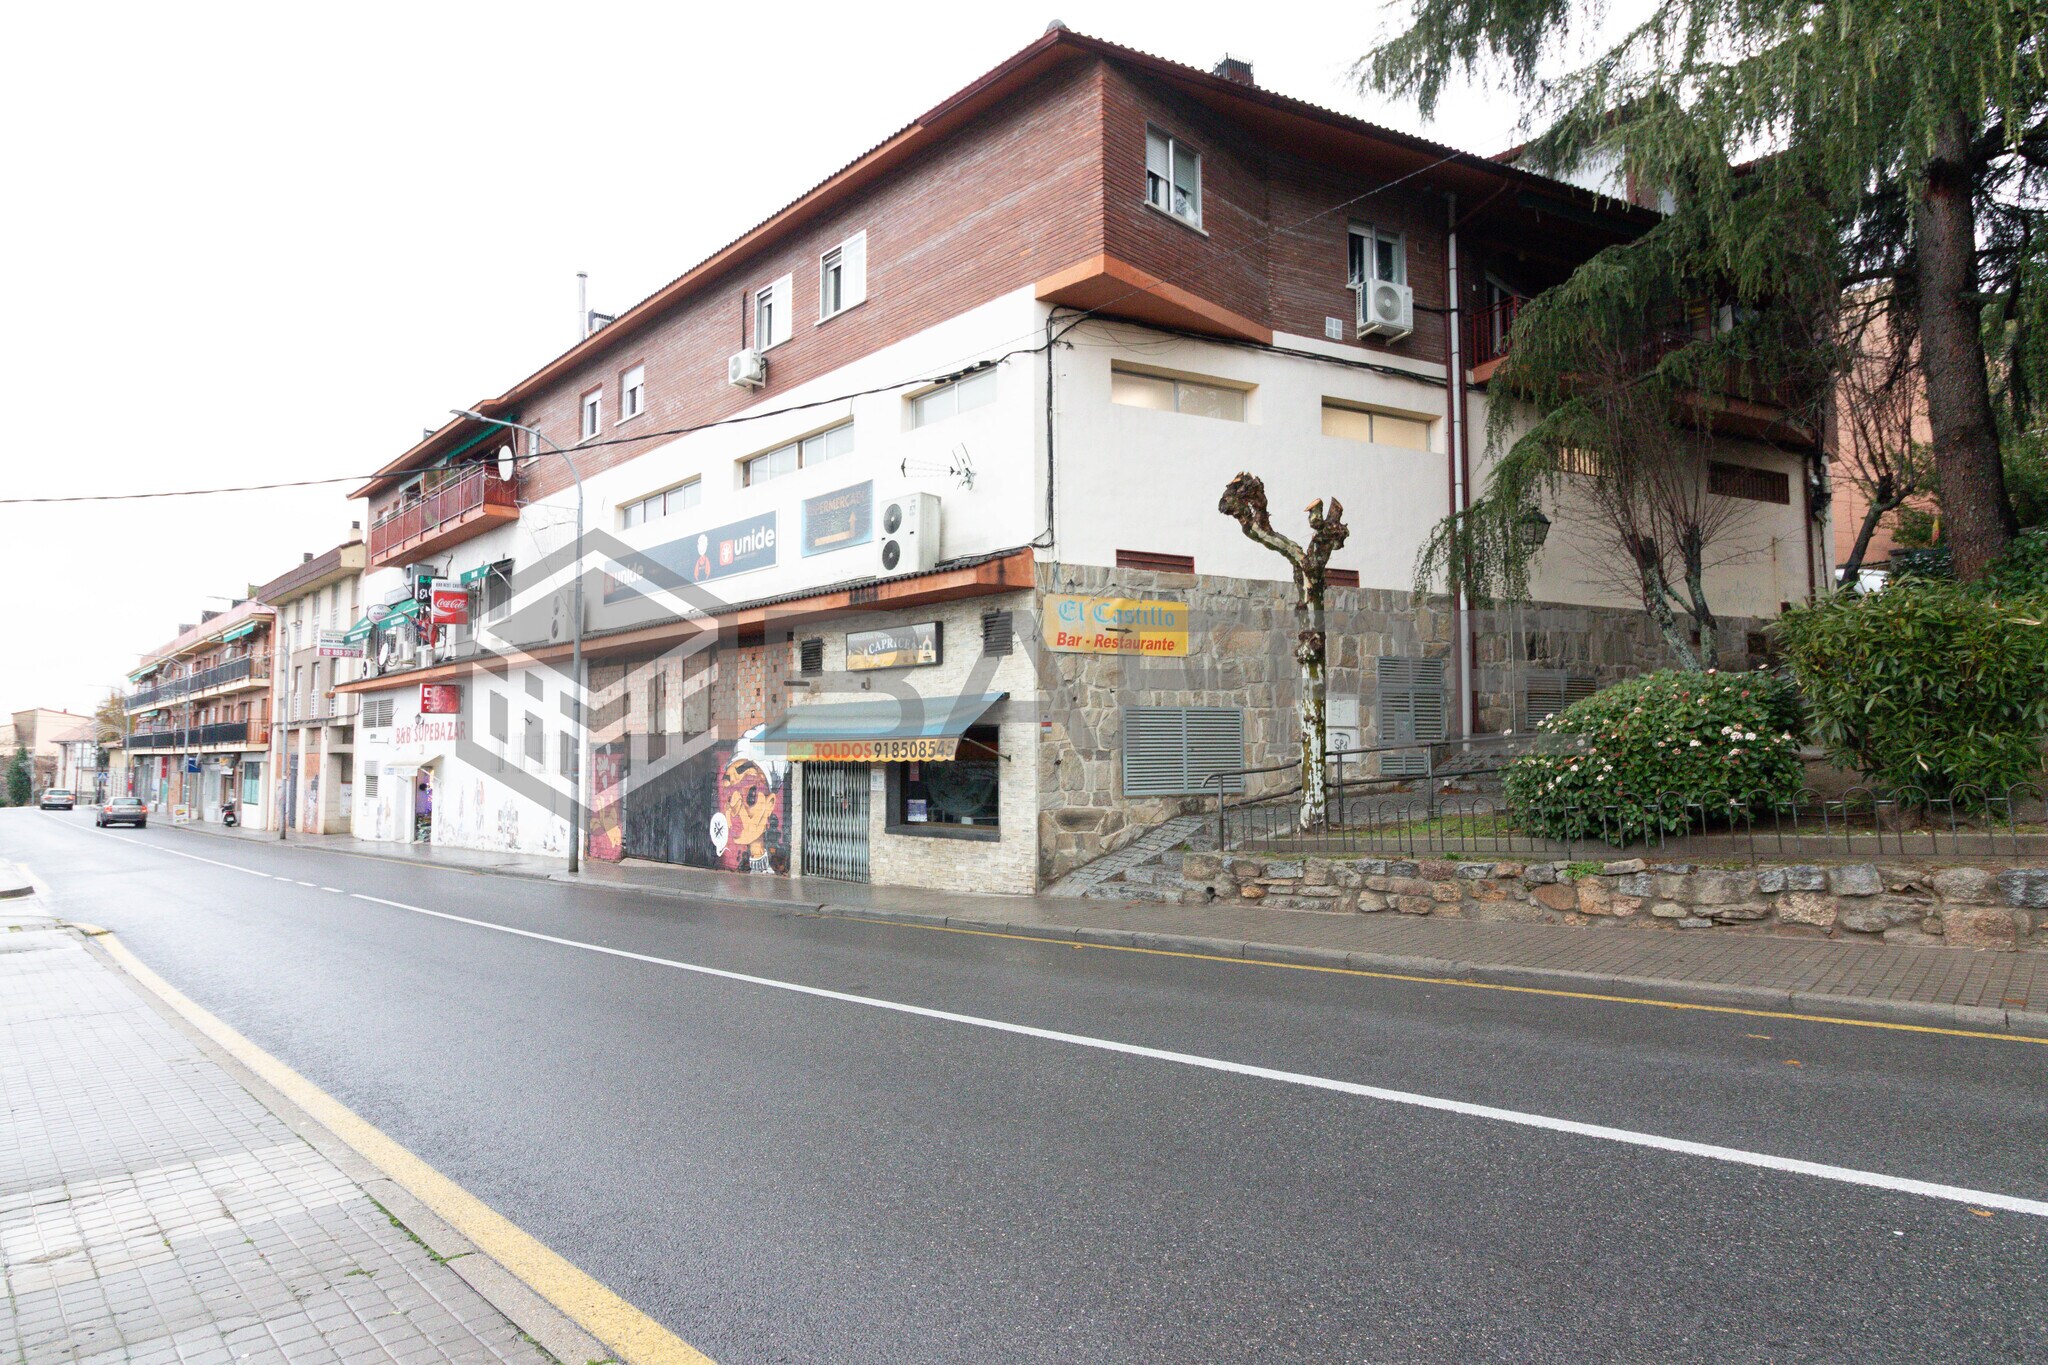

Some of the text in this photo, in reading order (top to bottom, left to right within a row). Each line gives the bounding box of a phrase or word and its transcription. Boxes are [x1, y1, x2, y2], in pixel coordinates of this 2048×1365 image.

[734, 525, 775, 556] unide
[614, 562, 644, 586] unide
[1058, 599, 1175, 627] El Castillo
[868, 637, 911, 654] CAPRICE
[1056, 631, 1083, 647] Bar
[1094, 634, 1176, 651] Restaurante
[813, 742, 873, 759] TOLDOS
[874, 740, 955, 759] 918508545
